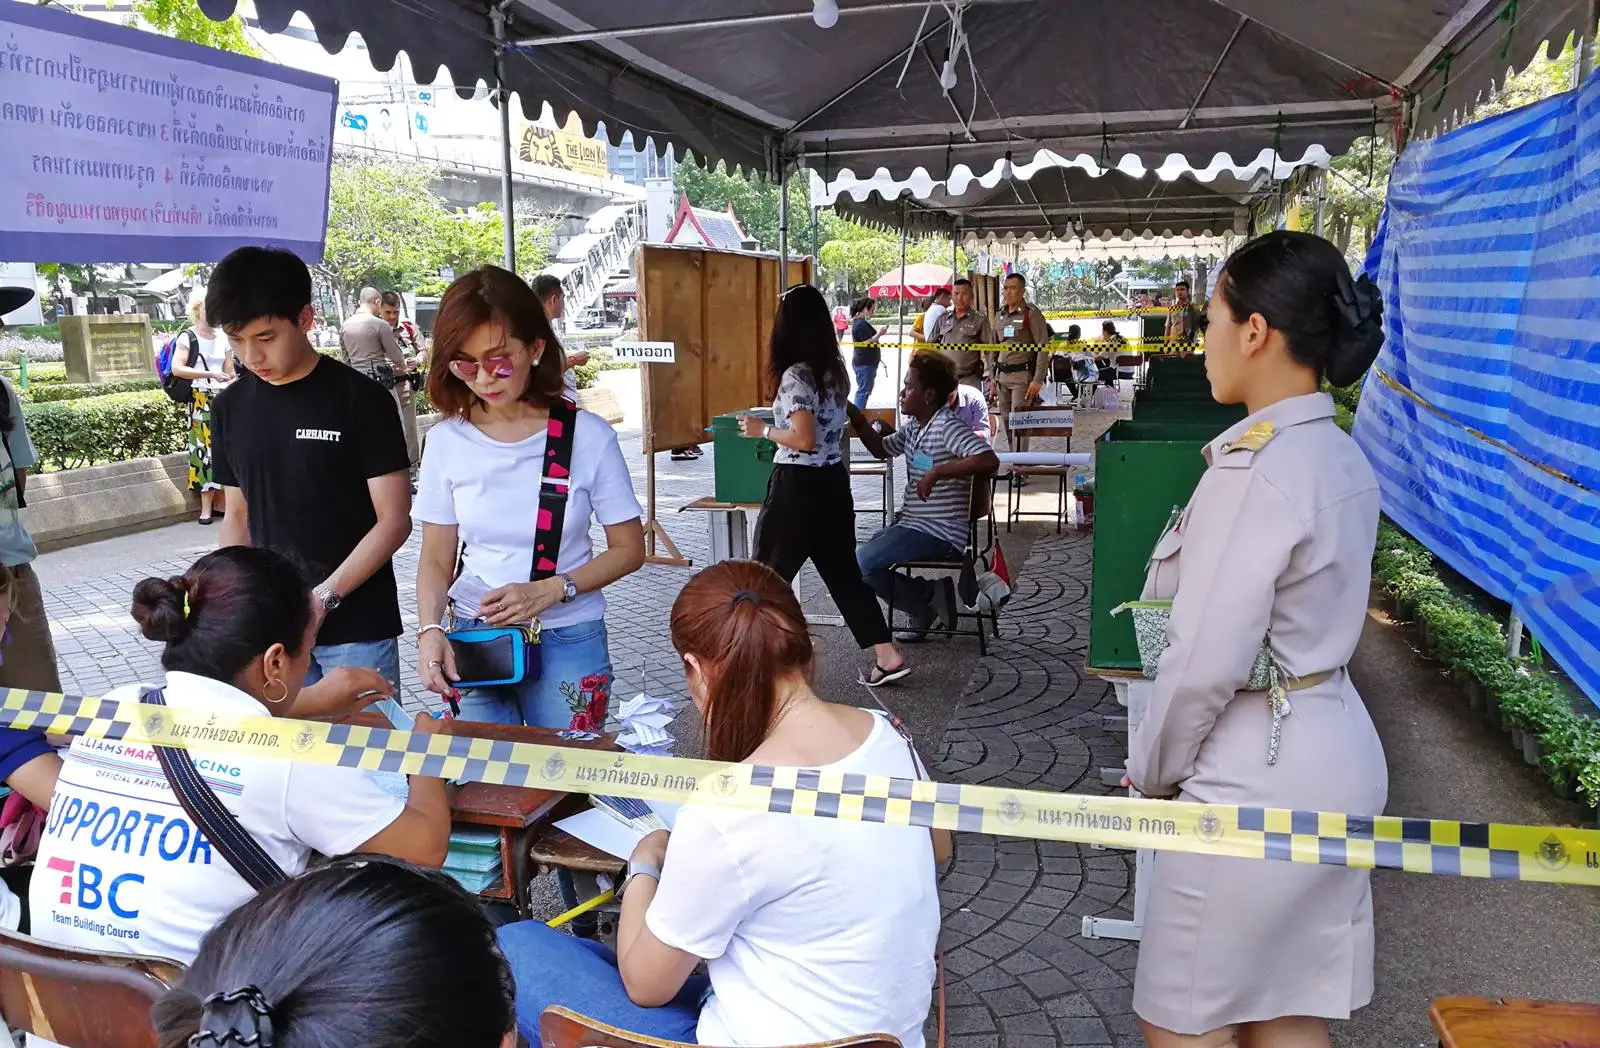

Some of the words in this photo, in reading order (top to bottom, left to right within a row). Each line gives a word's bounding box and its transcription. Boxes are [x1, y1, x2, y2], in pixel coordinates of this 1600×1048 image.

[565, 143, 579, 156] THE
[579, 142, 596, 161] LION
[615, 347, 672, 358] ทางออก
[295, 428, 341, 442] CARHARTT
[170, 712, 246, 748] แนวกั้นของ
[248, 730, 281, 748] กกต.
[95, 769, 131, 784] OFFICIAL
[575, 755, 659, 787] แนวกั้นของ
[662, 773, 700, 791] กกต.
[46, 790, 212, 864] UPPORTOR
[1037, 797, 1132, 832] แนวกั้นของ
[1137, 814, 1181, 837] กกต.
[51, 910, 72, 926] Team
[73, 916, 105, 936] Building
[106, 924, 140, 939] Course
